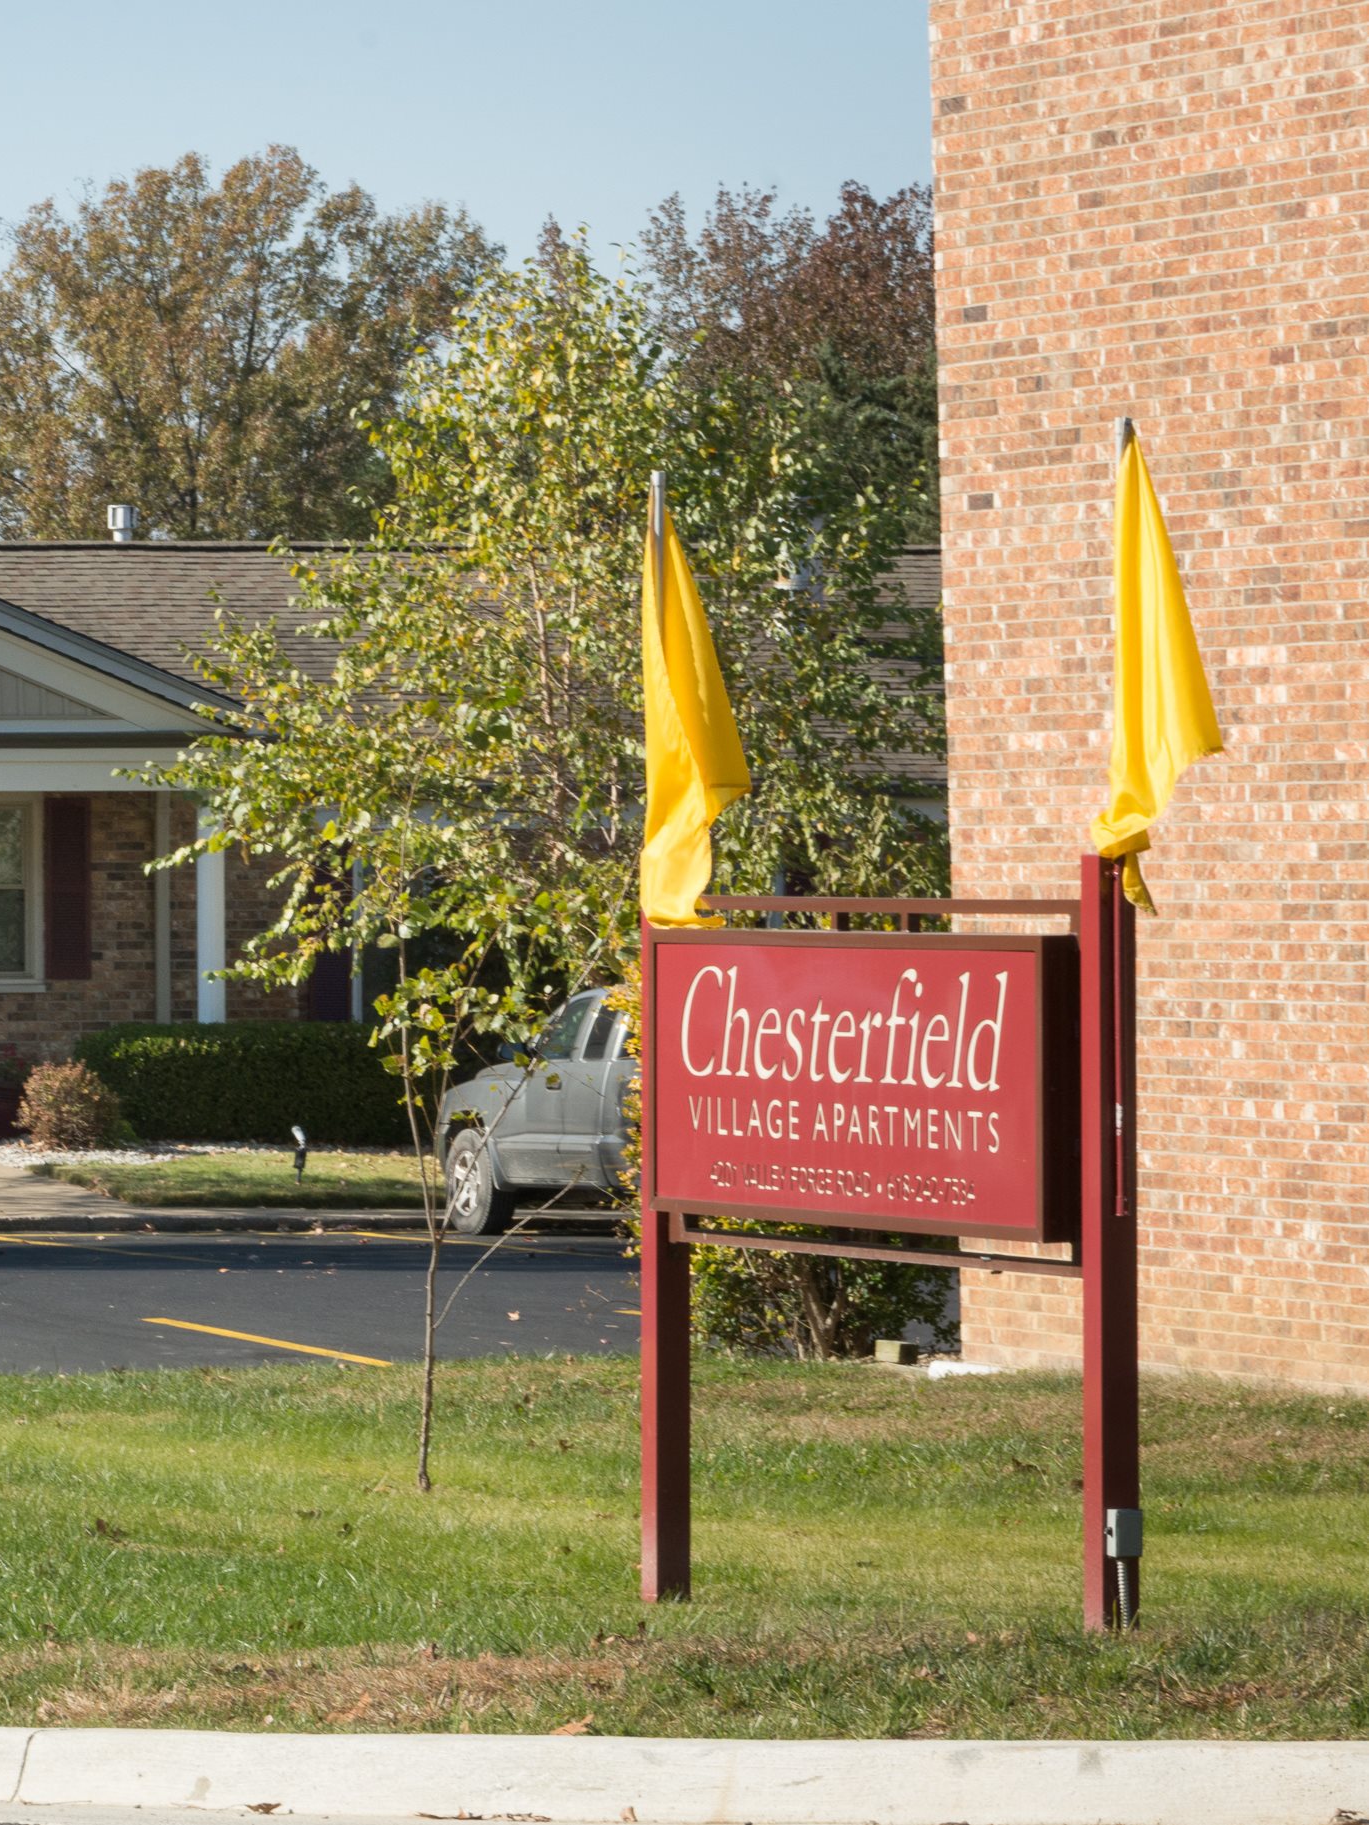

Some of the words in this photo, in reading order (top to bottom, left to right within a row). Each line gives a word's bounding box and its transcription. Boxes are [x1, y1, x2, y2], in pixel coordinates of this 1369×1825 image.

[681, 965, 1008, 1092] Chesterfield
[688, 1095, 800, 1140] VILLAGE
[812, 1103, 1000, 1154] APARTMENTS
[710, 1161, 737, 1188] 4201
[741, 1162, 787, 1191] VALLEY
[789, 1166, 833, 1194] FORGE
[836, 1169, 870, 1198] ROAD
